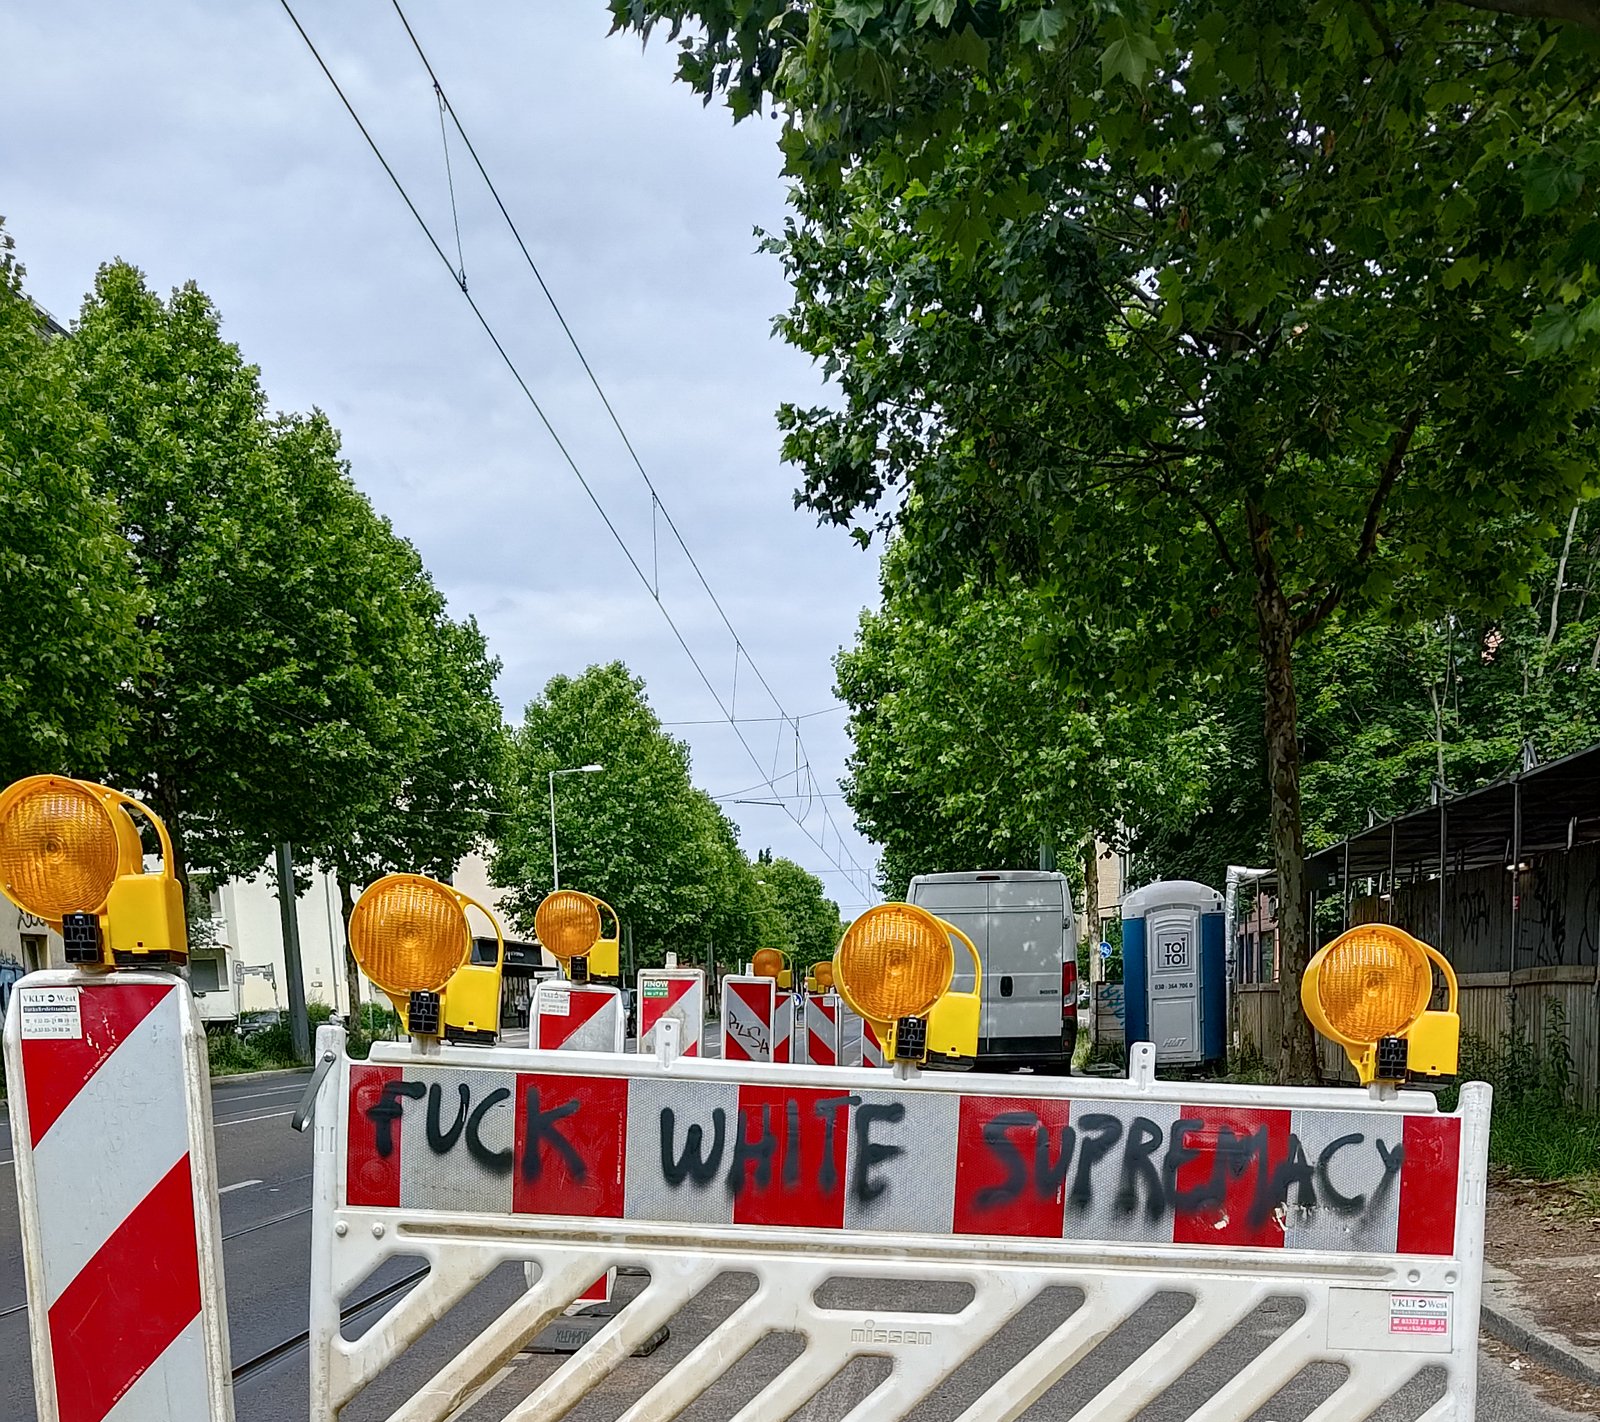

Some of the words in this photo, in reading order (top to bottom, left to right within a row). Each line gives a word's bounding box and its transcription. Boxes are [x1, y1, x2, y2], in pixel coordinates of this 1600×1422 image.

[1164, 940, 1186, 953] TOI
[1164, 953, 1186, 965] TOI
[366, 1080, 587, 1183] FUCK
[659, 1095, 907, 1205] WHITE
[972, 1110, 1406, 1236] SUPREMACY
[1392, 1299, 1417, 1307] VKLT
[1427, 1300, 1447, 1309] West
[851, 1319, 933, 1345] nissen
